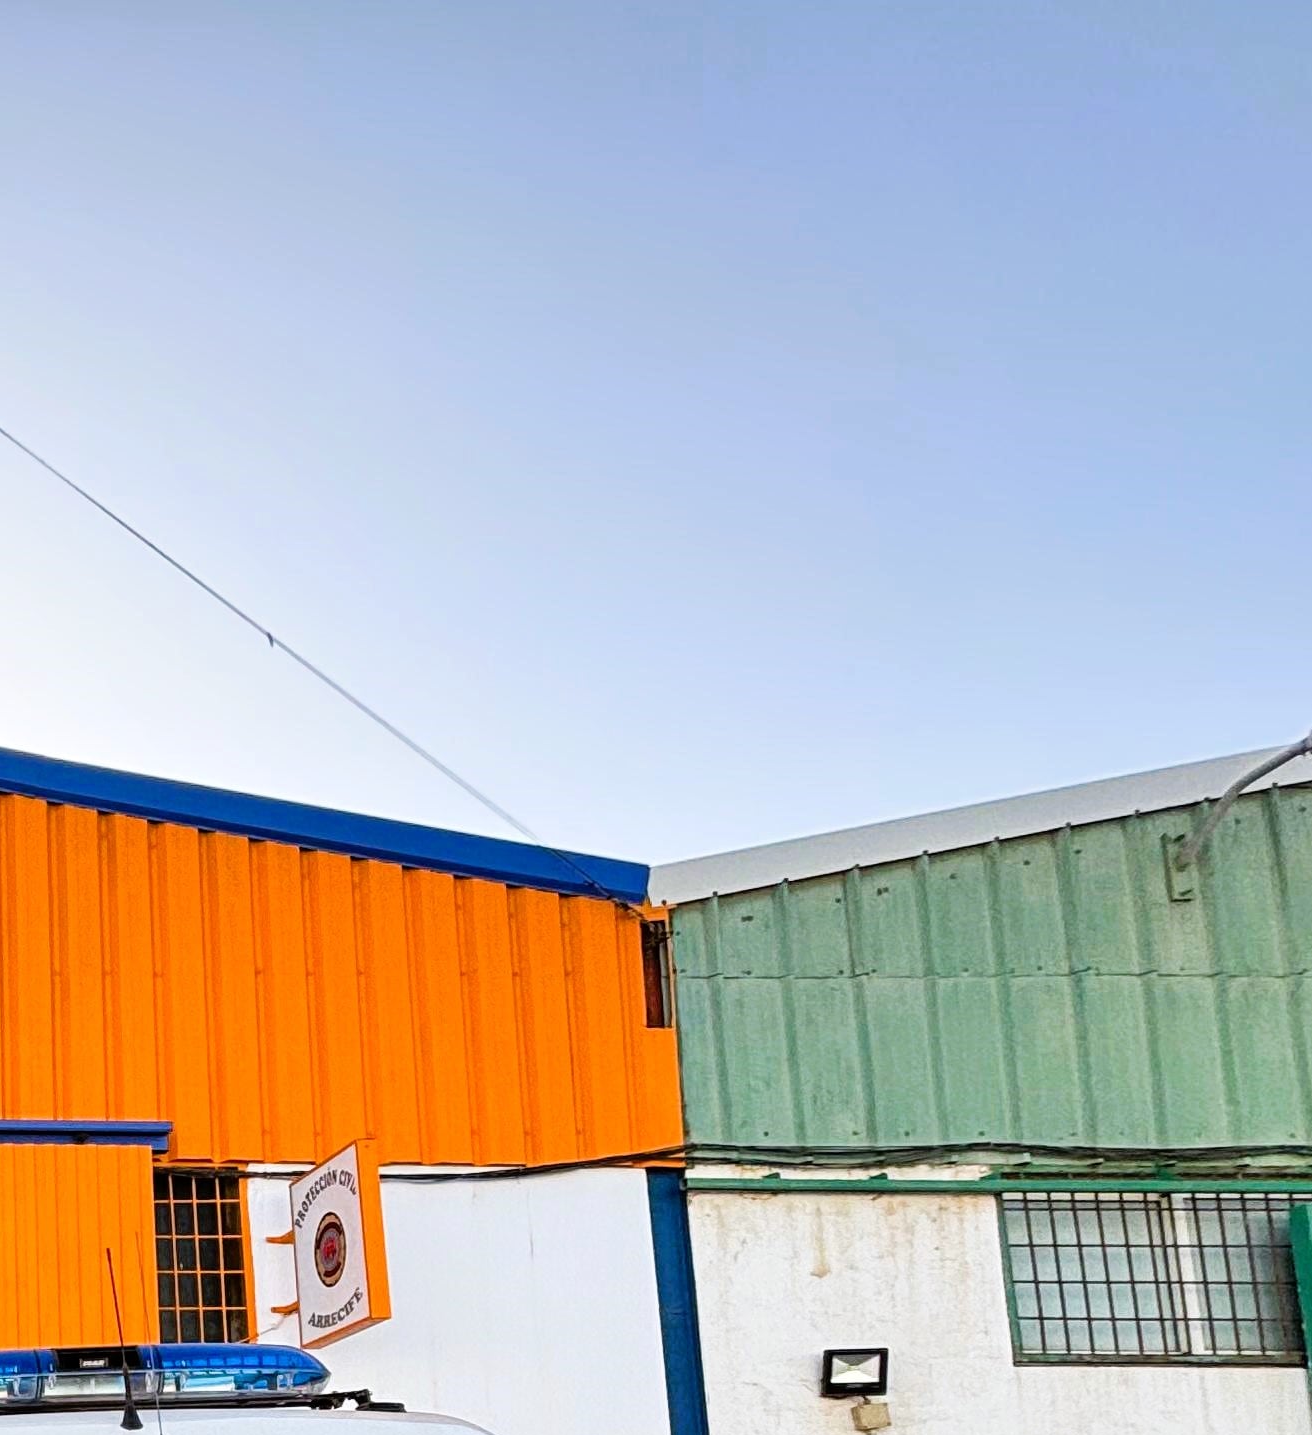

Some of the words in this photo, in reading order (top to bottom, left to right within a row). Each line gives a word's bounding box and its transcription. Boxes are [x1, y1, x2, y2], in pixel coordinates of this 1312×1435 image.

[295, 1167, 337, 1229] PROTECCIÓN
[339, 1169, 358, 1196] CIVIL
[308, 1287, 364, 1329] ARRECIFE
